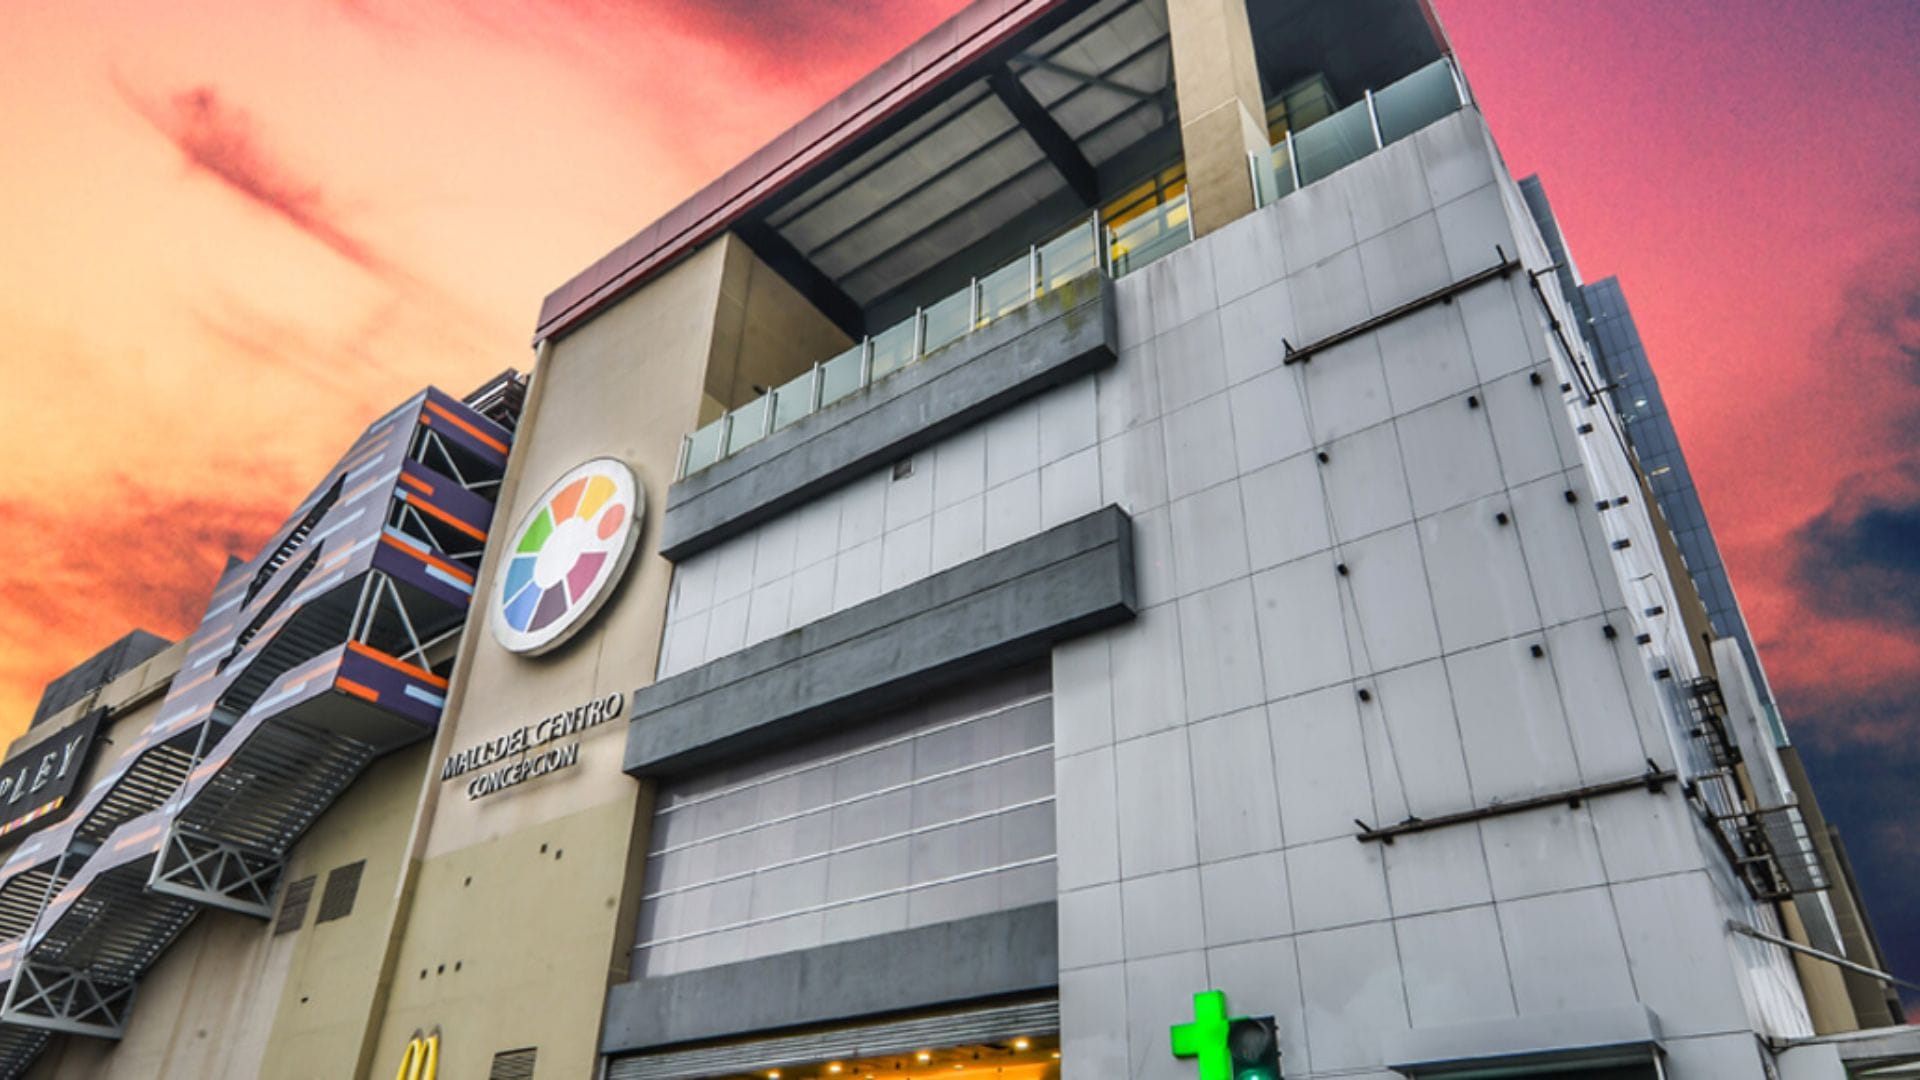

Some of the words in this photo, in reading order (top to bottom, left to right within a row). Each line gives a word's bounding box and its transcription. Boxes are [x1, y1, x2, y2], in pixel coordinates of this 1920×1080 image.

[441, 741, 493, 781] MALL
[494, 726, 531, 761] DEL
[535, 692, 624, 747] CENTRO
